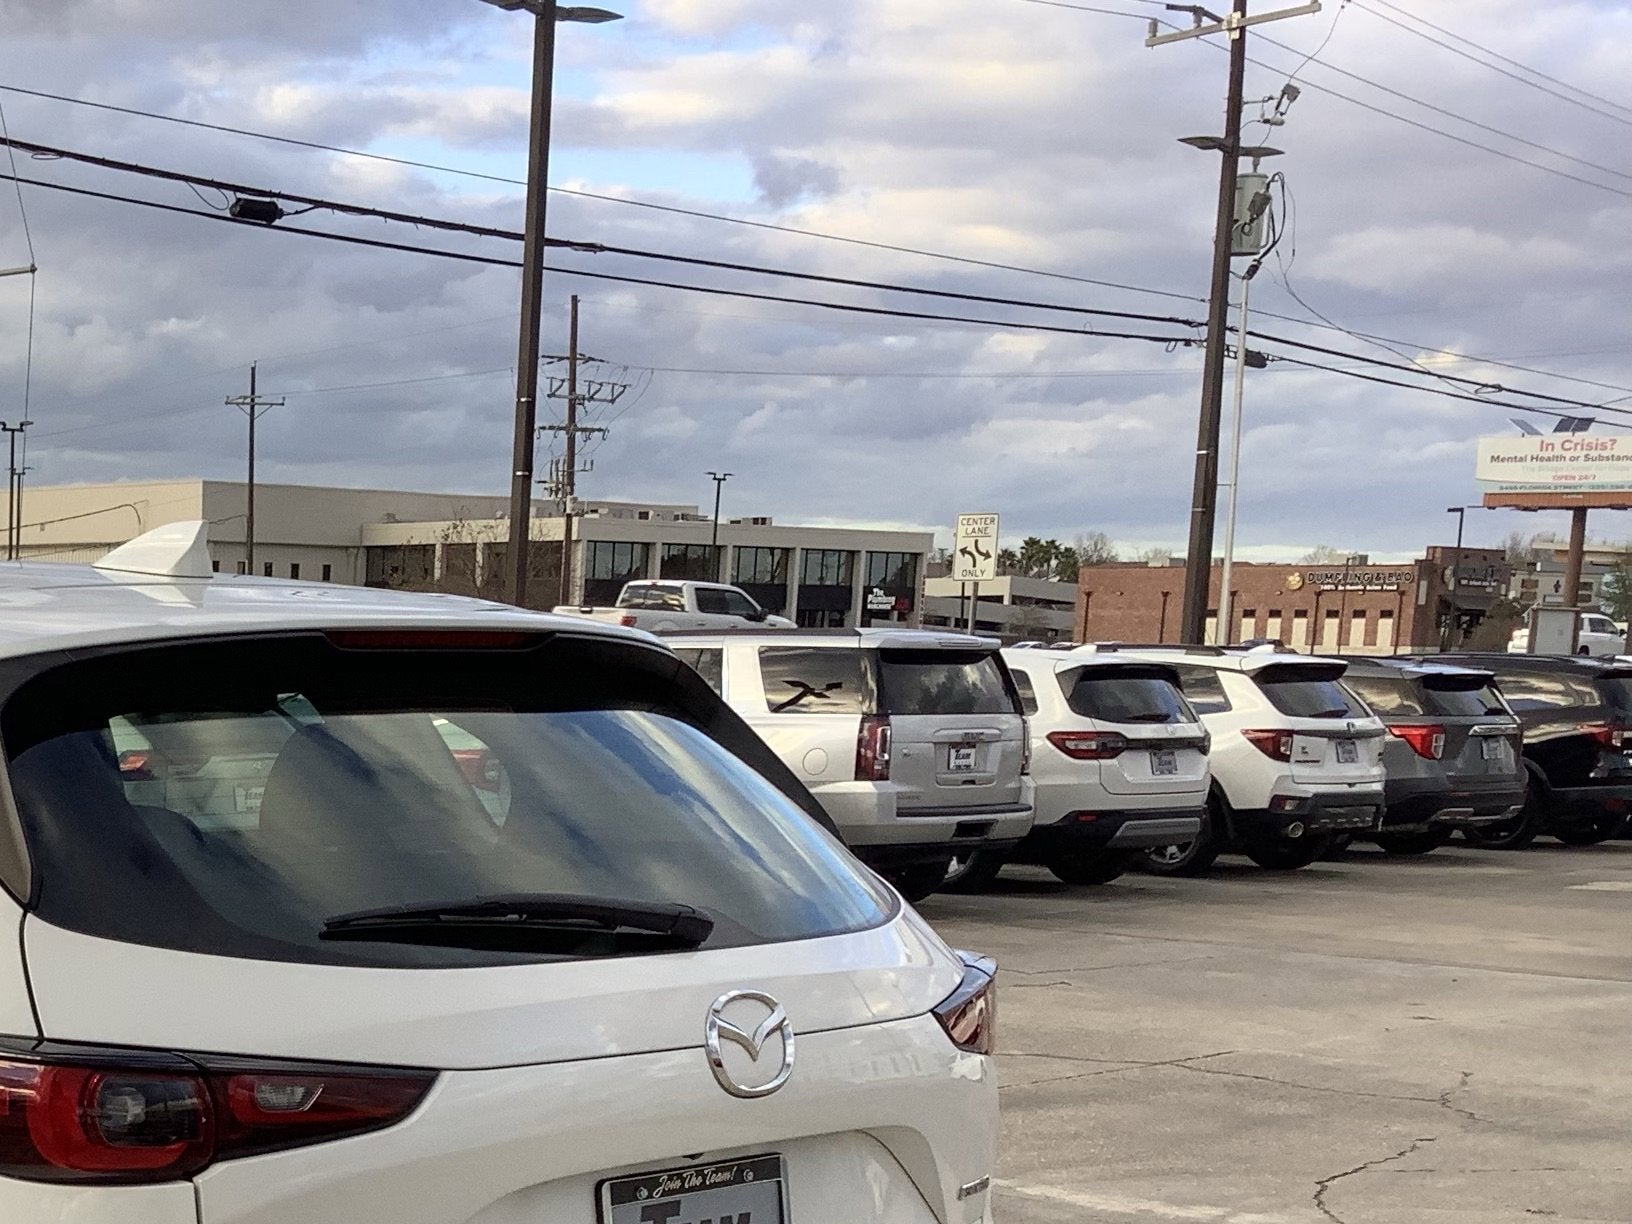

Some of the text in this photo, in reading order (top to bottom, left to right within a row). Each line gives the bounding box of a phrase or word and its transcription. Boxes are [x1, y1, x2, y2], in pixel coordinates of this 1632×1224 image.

[1539, 437, 1617, 452] In Crisis?
[1490, 454, 1527, 463] Mental
[1530, 453, 1566, 463] Health
[1569, 454, 1581, 462] or
[961, 517, 995, 526] CENTER
[966, 527, 990, 535] LANE
[961, 569, 986, 577] ONLY
[1308, 572, 1372, 584] DUMPING
[653, 1166, 737, 1198] Join The Team!
